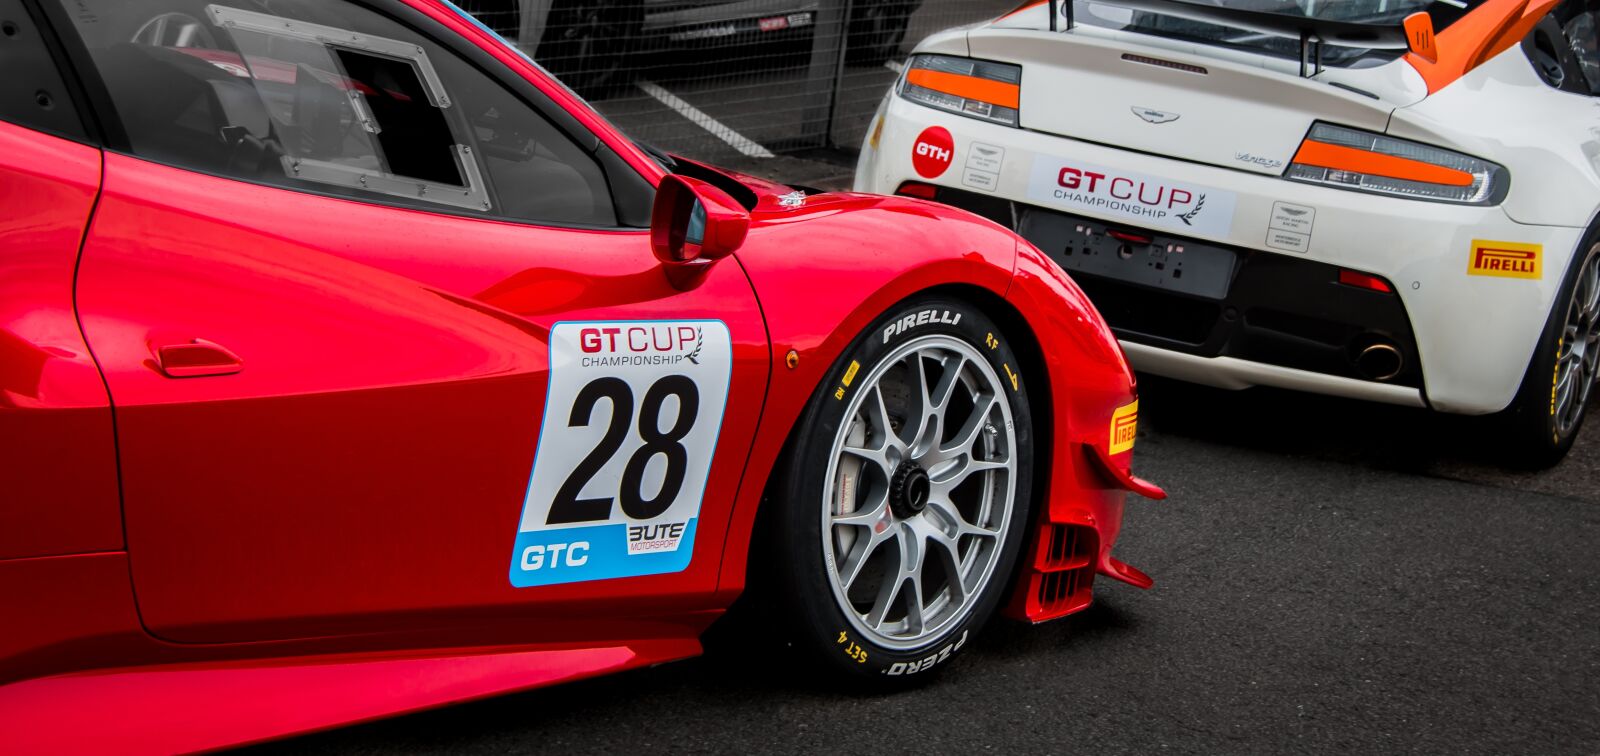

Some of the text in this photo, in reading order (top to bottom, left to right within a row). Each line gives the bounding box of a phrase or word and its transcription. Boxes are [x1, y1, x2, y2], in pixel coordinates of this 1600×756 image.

[916, 142, 950, 162] GTH
[1057, 167, 1192, 209] GT CUP
[1053, 189, 1167, 219] CHAMPIONSHIP
[1474, 247, 1536, 273] PIRELLI
[580, 326, 696, 353] GT CUP
[883, 309, 961, 344] PIRELLI
[581, 354, 683, 368] CHAMPIONSHIP
[545, 374, 700, 525] 28
[629, 522, 685, 541] BUTE
[630, 539, 678, 551] MOTORSPORT
[520, 541, 590, 571] GTC
[837, 631, 868, 664] SET 4
